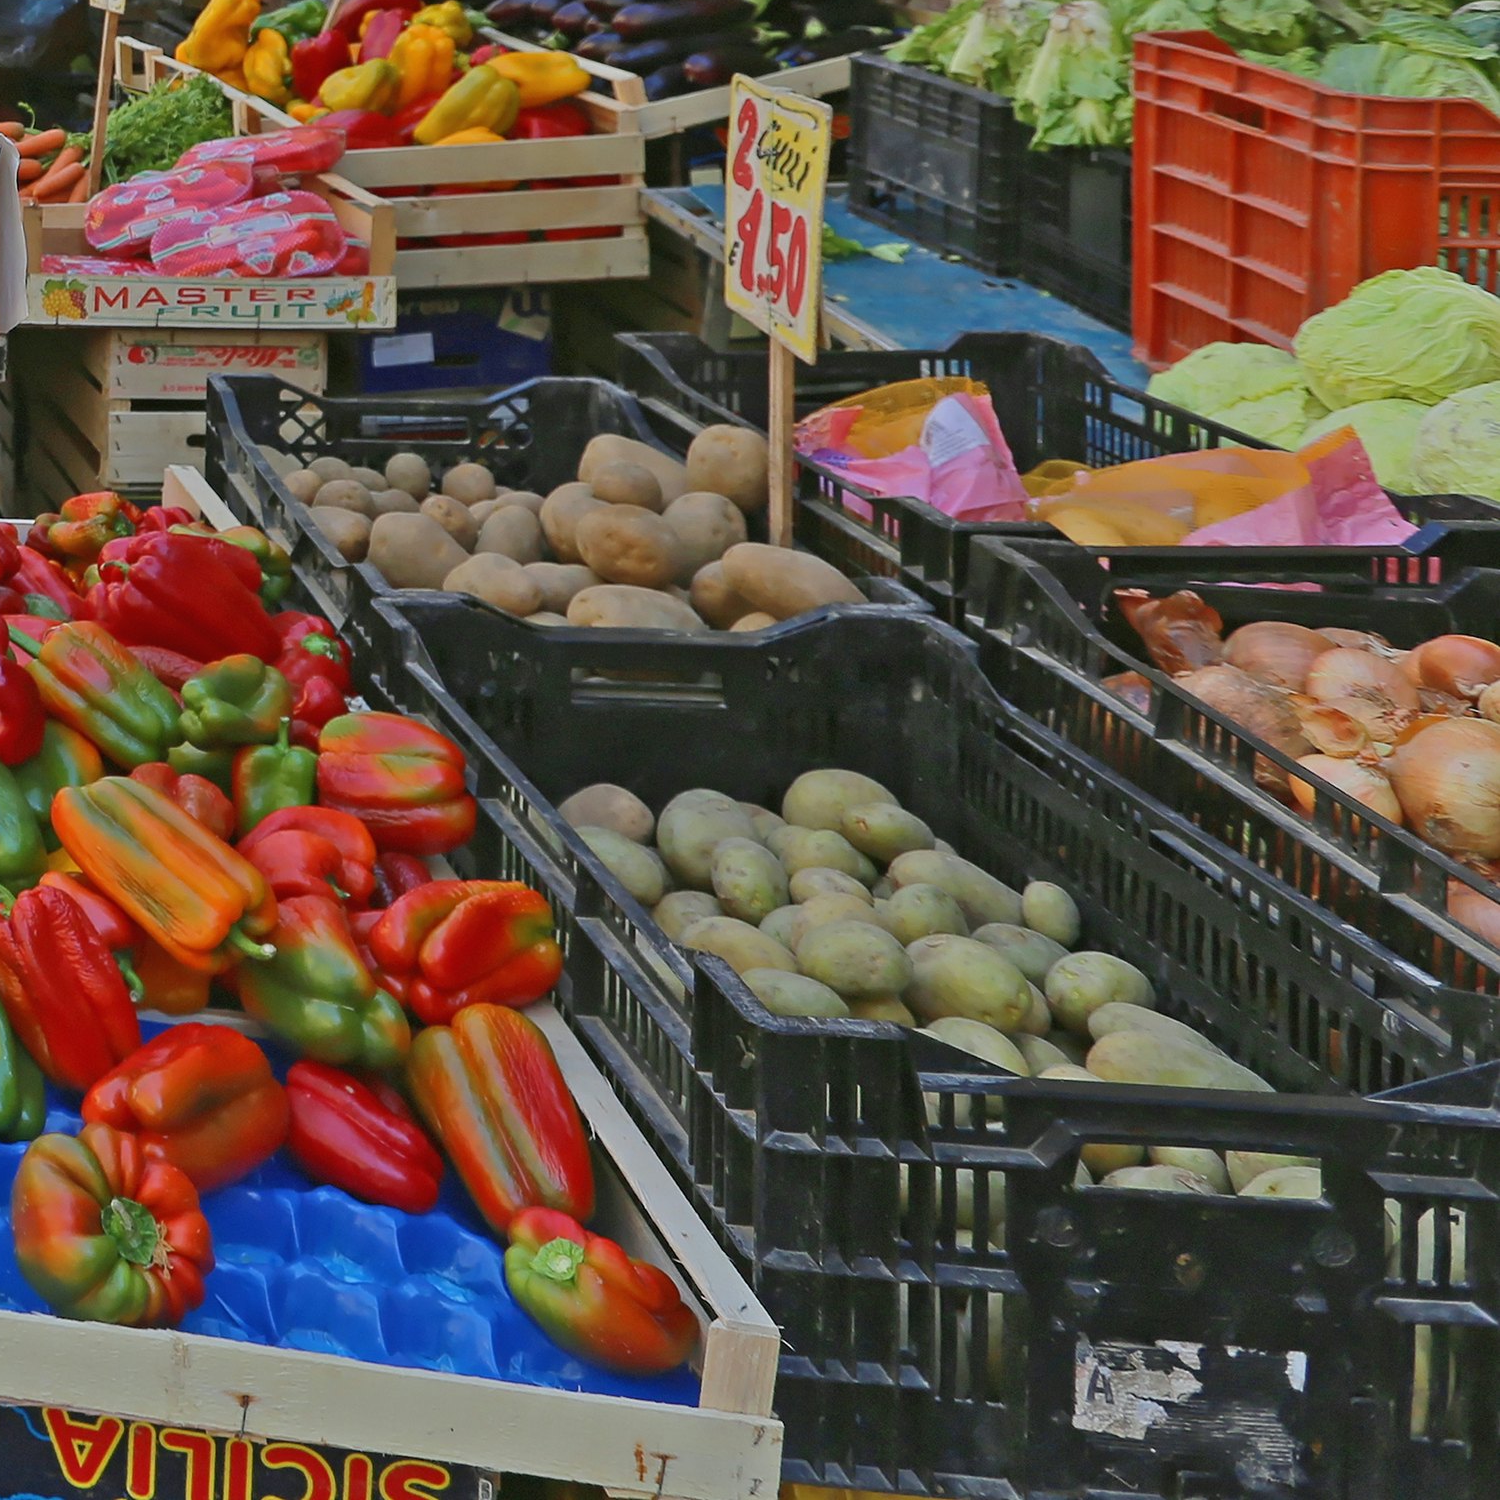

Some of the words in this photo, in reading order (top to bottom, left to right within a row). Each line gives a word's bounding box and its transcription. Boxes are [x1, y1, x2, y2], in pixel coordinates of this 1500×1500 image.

[732, 97, 759, 191] 2
[93, 286, 317, 313] MASTER
[156, 303, 318, 319] FRUIT
